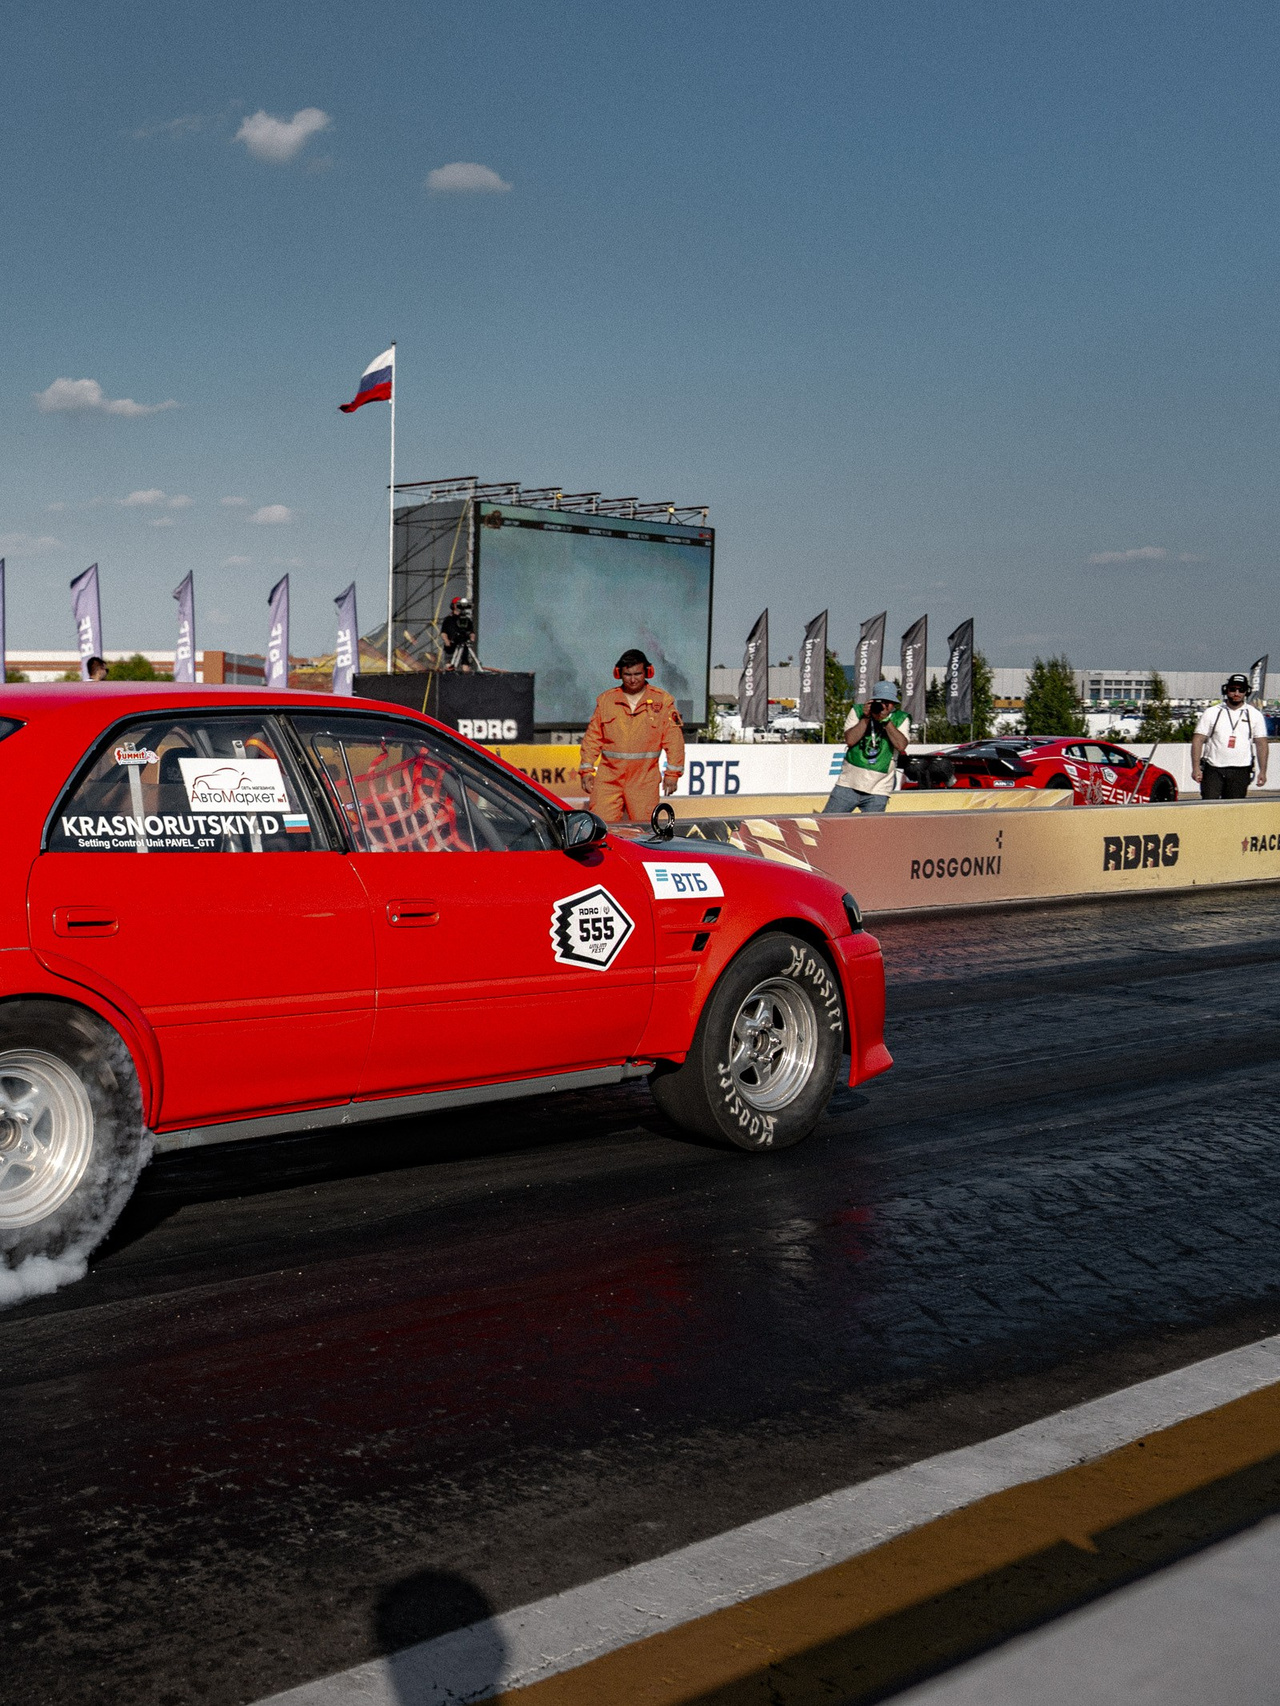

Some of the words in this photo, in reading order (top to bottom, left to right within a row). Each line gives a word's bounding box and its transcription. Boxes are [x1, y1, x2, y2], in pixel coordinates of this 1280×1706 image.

[457, 719, 518, 739] RDRC
[688, 760, 740, 795] ВТБ
[191, 790, 275, 806] АвтоМаркет
[61, 815, 279, 837] KRASNORUTSKIY.D
[78, 838, 111, 849] Setting
[112, 838, 145, 848] Control
[146, 838, 165, 848] Unit
[165, 838, 215, 849] PAVEL_GTT
[1103, 833, 1180, 871] RDRC
[910, 856, 1001, 880] ROSGONKI
[671, 873, 708, 892] ВТБ
[579, 907, 599, 915] RDRC
[579, 916, 614, 942] 555
